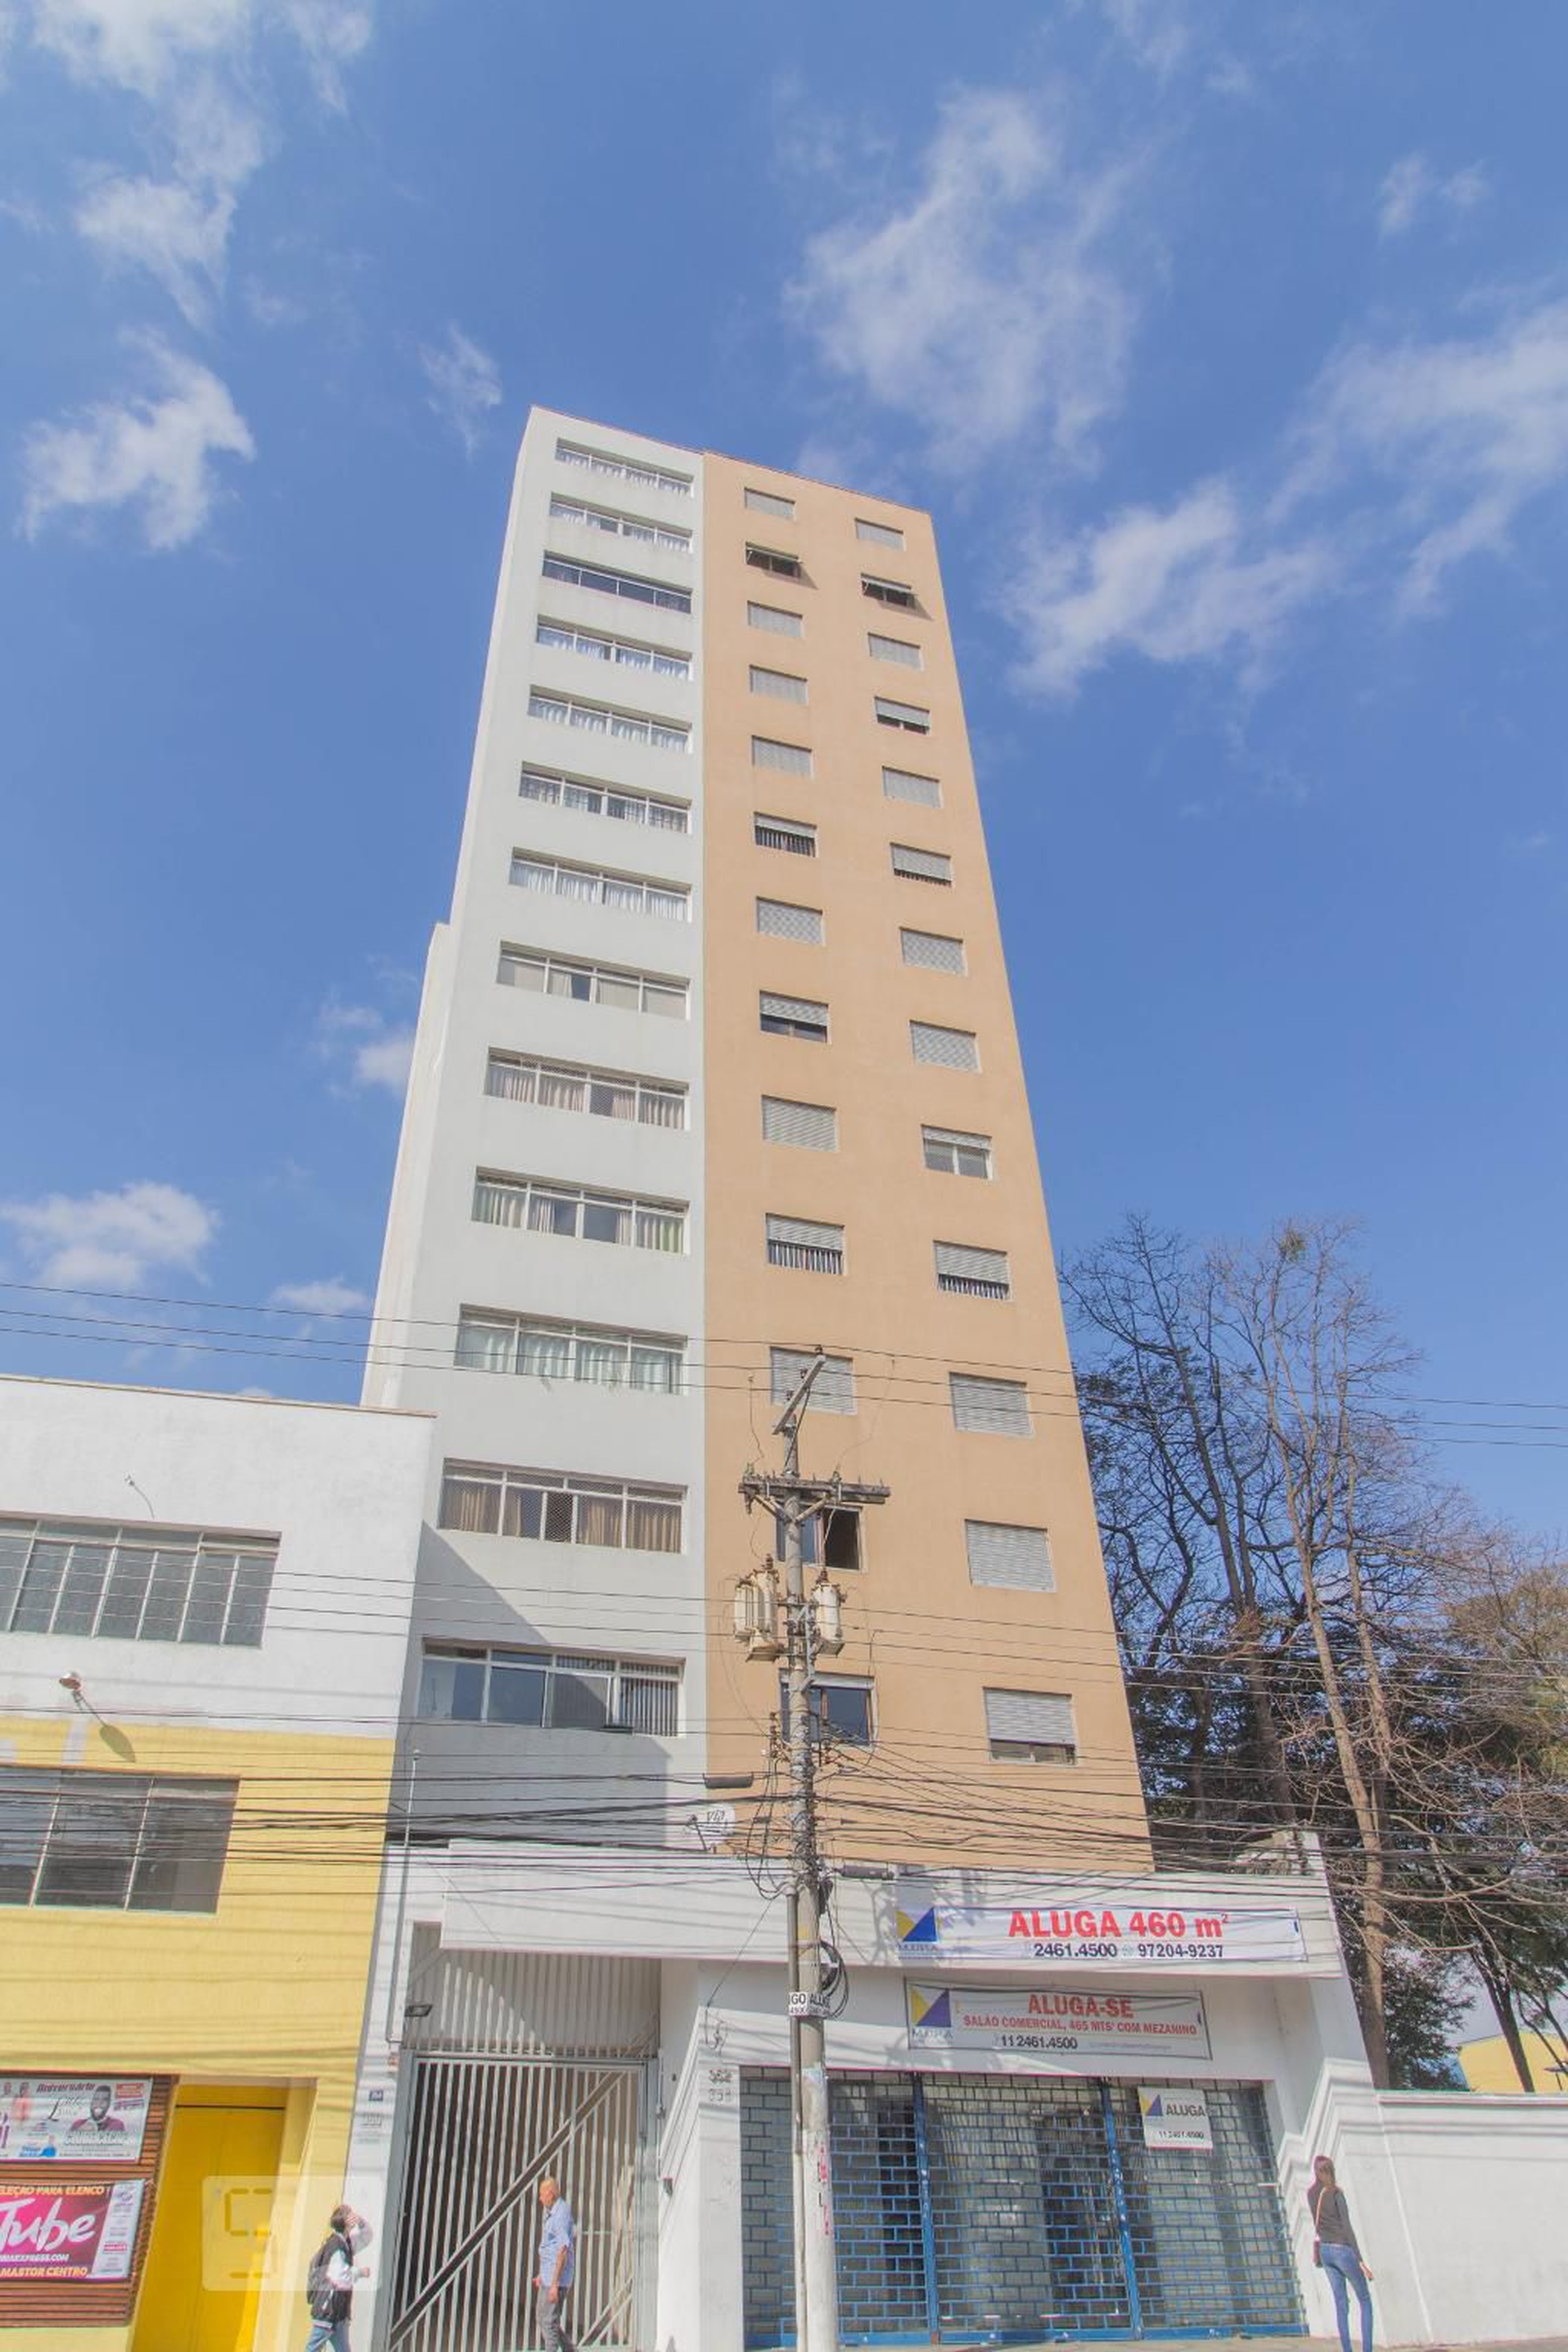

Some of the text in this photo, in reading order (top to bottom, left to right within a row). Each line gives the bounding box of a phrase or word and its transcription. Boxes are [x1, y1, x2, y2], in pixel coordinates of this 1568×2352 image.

[1008, 1910, 1121, 1938] ALUGA
[1129, 1911, 1185, 1938] 460
[1034, 1943, 1223, 1958] 2461.4500 97204-9237
[1028, 1994, 1134, 2018] ALUGA-SE
[1117, 2022, 1142, 2033] COM
[1143, 2023, 1196, 2035] MEZANINO
[1166, 2104, 1206, 2116] ALUGA
[66, 2186, 105, 2196] ELENCO
[47, 2267, 88, 2277] CENTRO
